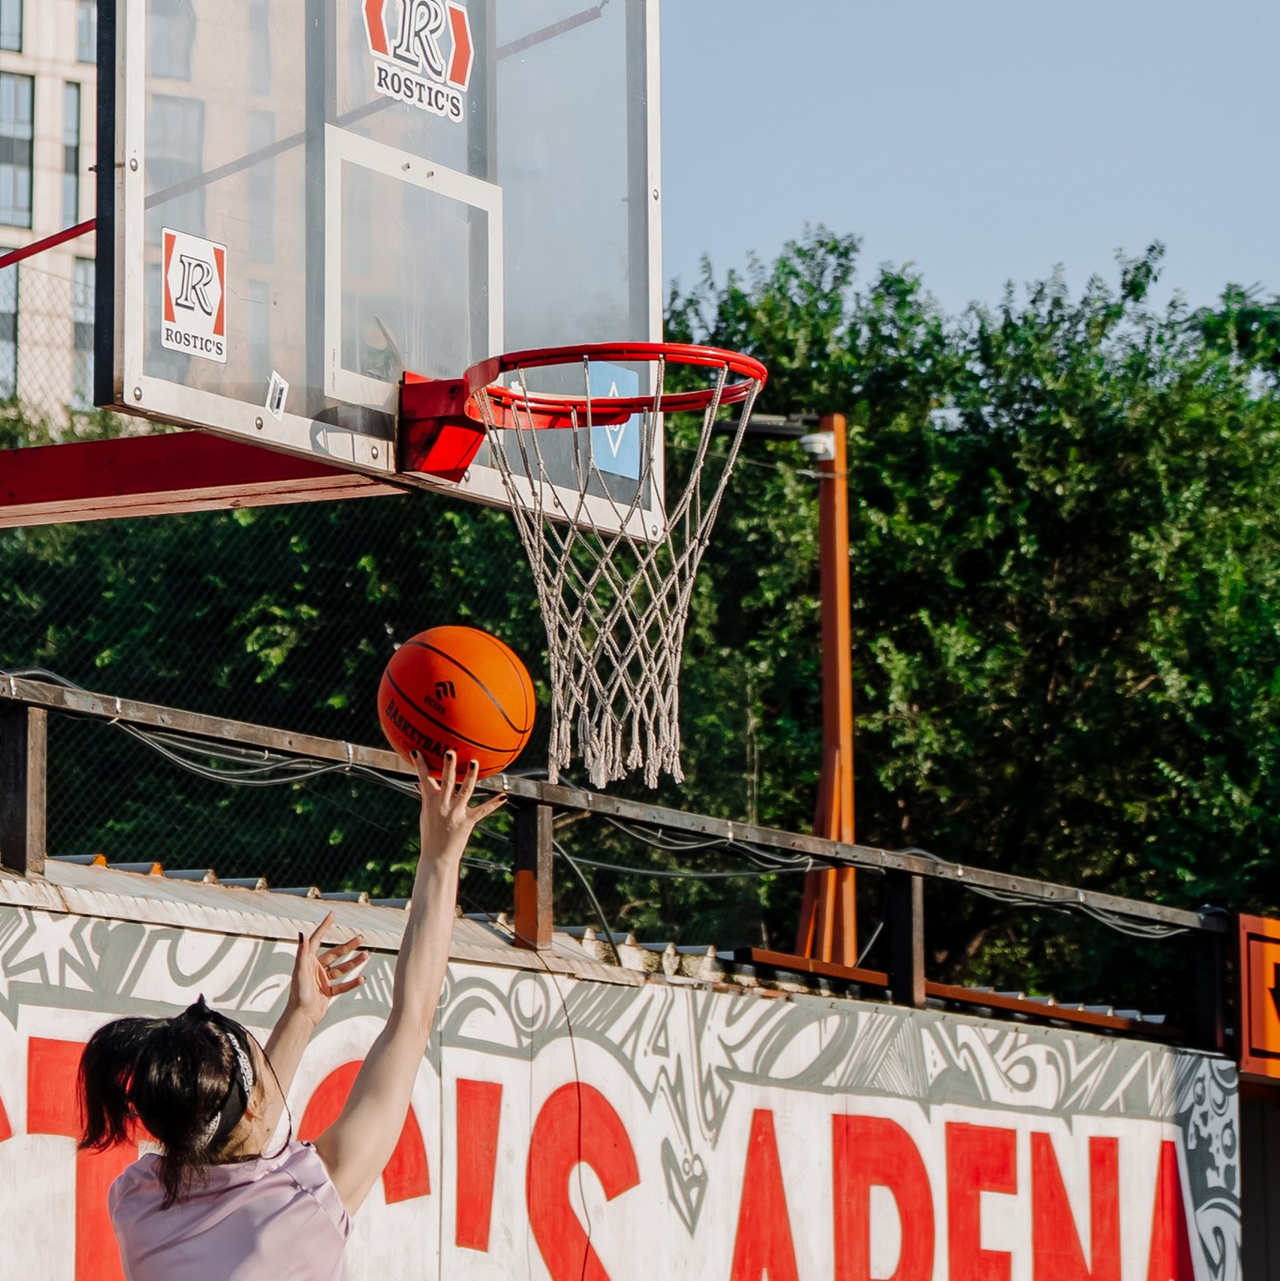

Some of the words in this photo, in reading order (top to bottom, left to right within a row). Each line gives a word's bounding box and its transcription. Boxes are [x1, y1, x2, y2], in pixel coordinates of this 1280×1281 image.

[377, 66, 461, 117] ROSTIC'S
[175, 254, 213, 316] R
[165, 328, 224, 356] ROSTIC'S
[386, 698, 458, 758] BASKETBAL
